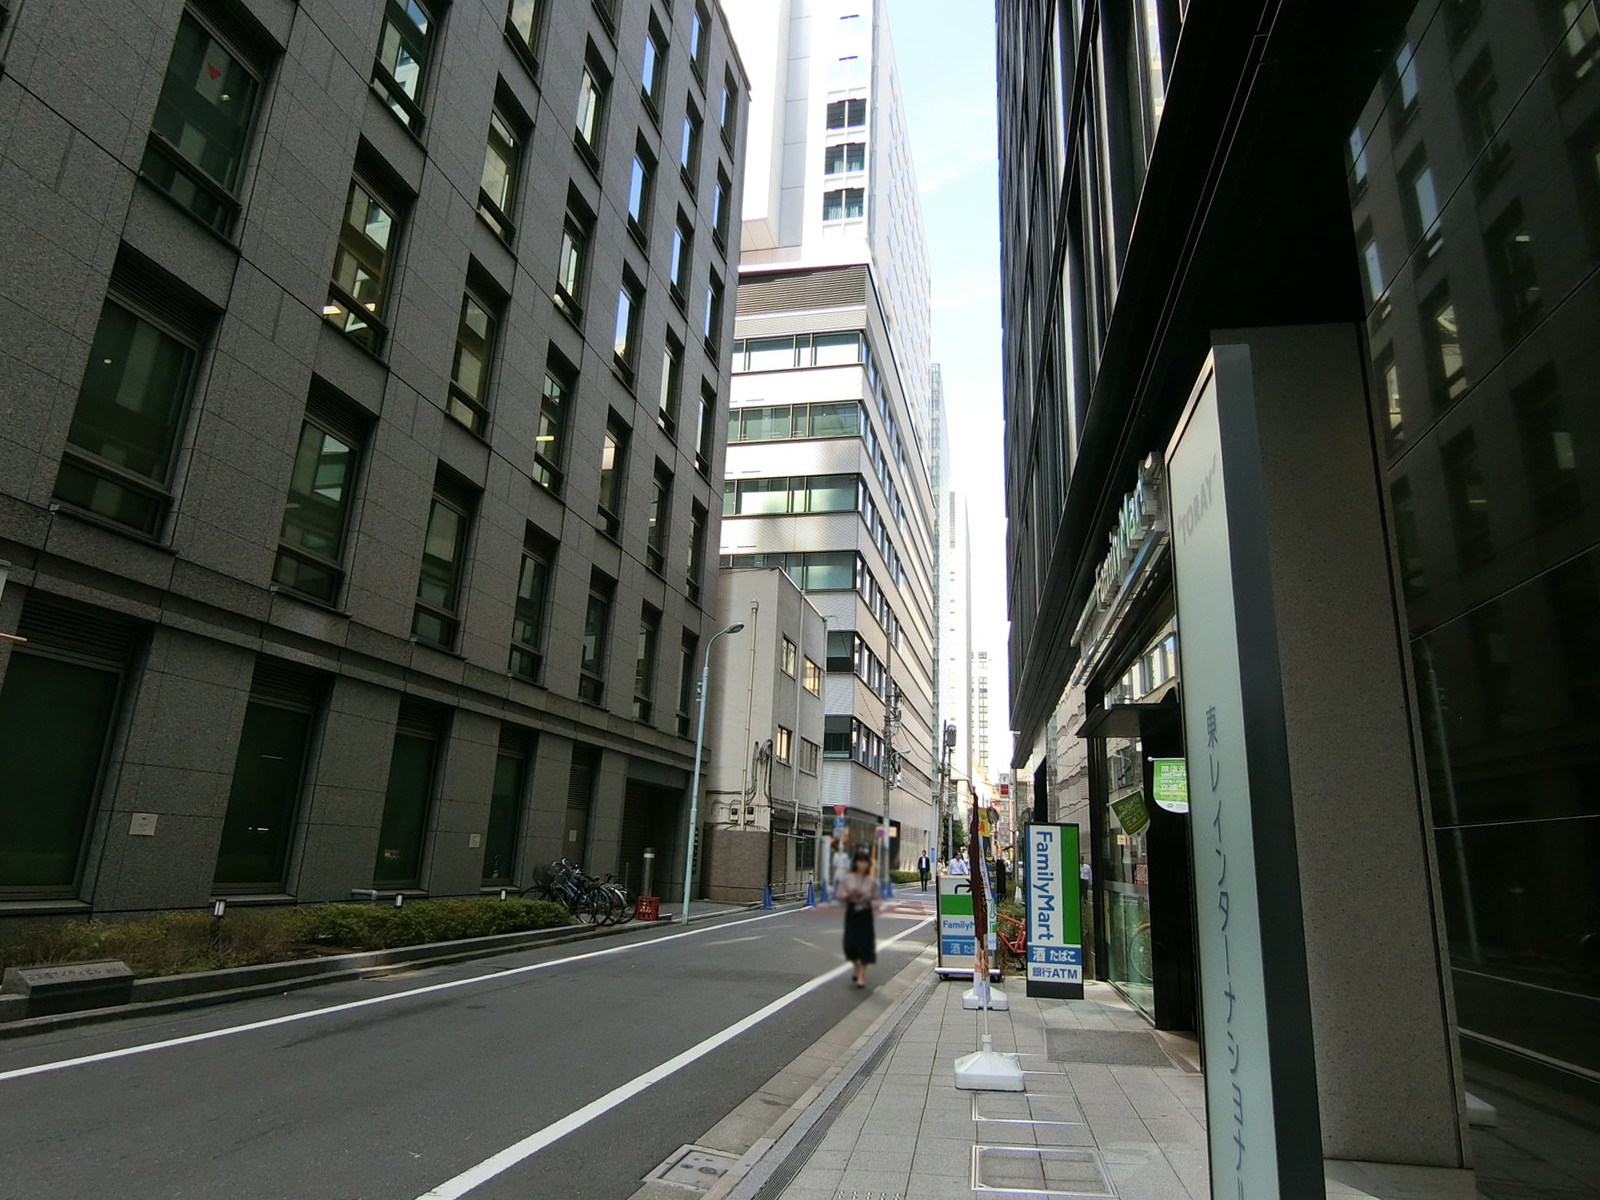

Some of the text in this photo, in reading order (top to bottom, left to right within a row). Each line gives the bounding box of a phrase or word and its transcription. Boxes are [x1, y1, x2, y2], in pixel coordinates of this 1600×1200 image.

[1033, 831, 1055, 941] FamilyMart
[950, 942, 961, 955] 酒
[1032, 947, 1077, 963] 酒 たばこ
[1031, 966, 1078, 980] 銀行ATM
